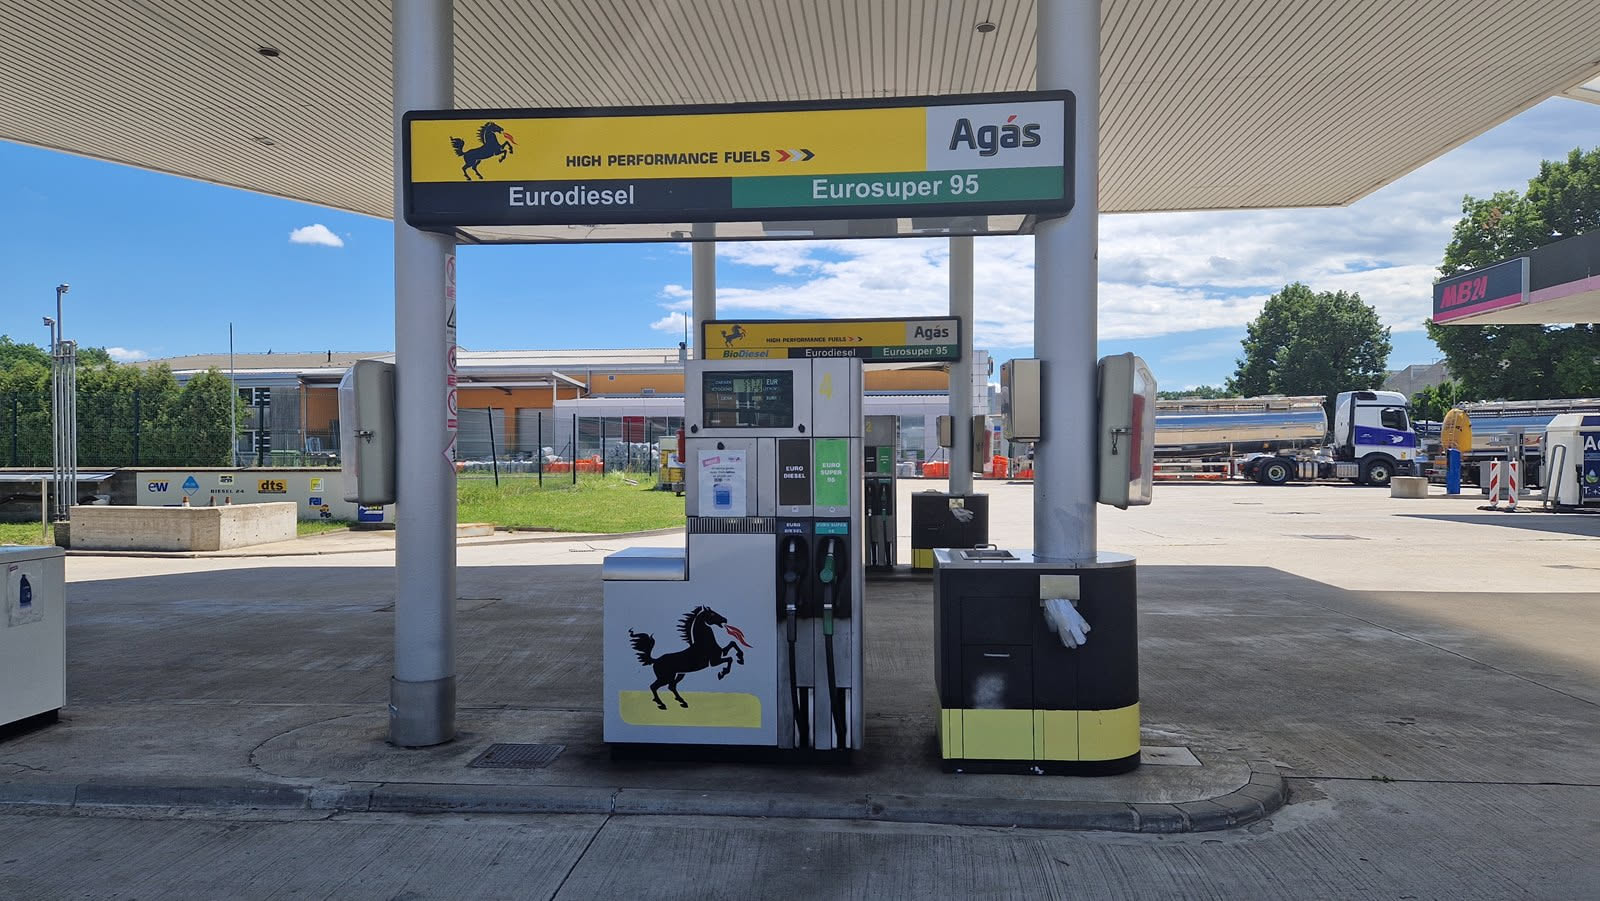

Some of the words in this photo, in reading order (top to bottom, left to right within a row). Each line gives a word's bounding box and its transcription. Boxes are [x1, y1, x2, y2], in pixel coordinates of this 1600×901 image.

[949, 115, 1041, 157] Agás
[566, 155, 602, 167] HIGH
[608, 151, 718, 167] PERFORMANCE
[724, 150, 770, 163] FUELS
[812, 177, 943, 201] Eurosuper
[949, 173, 980, 195] 95
[508, 185, 635, 207] Eurodiesel
[1440, 275, 1488, 309] MB24
[914, 325, 950, 341] Agás
[723, 350, 769, 358] BioDiesel
[805, 348, 856, 358] Eurodiesel
[883, 347, 933, 356] Eurosuper
[935, 346, 948, 355] 95
[819, 371, 832, 400] 4
[148, 482, 168, 492] ew
[261, 480, 284, 491] dts
